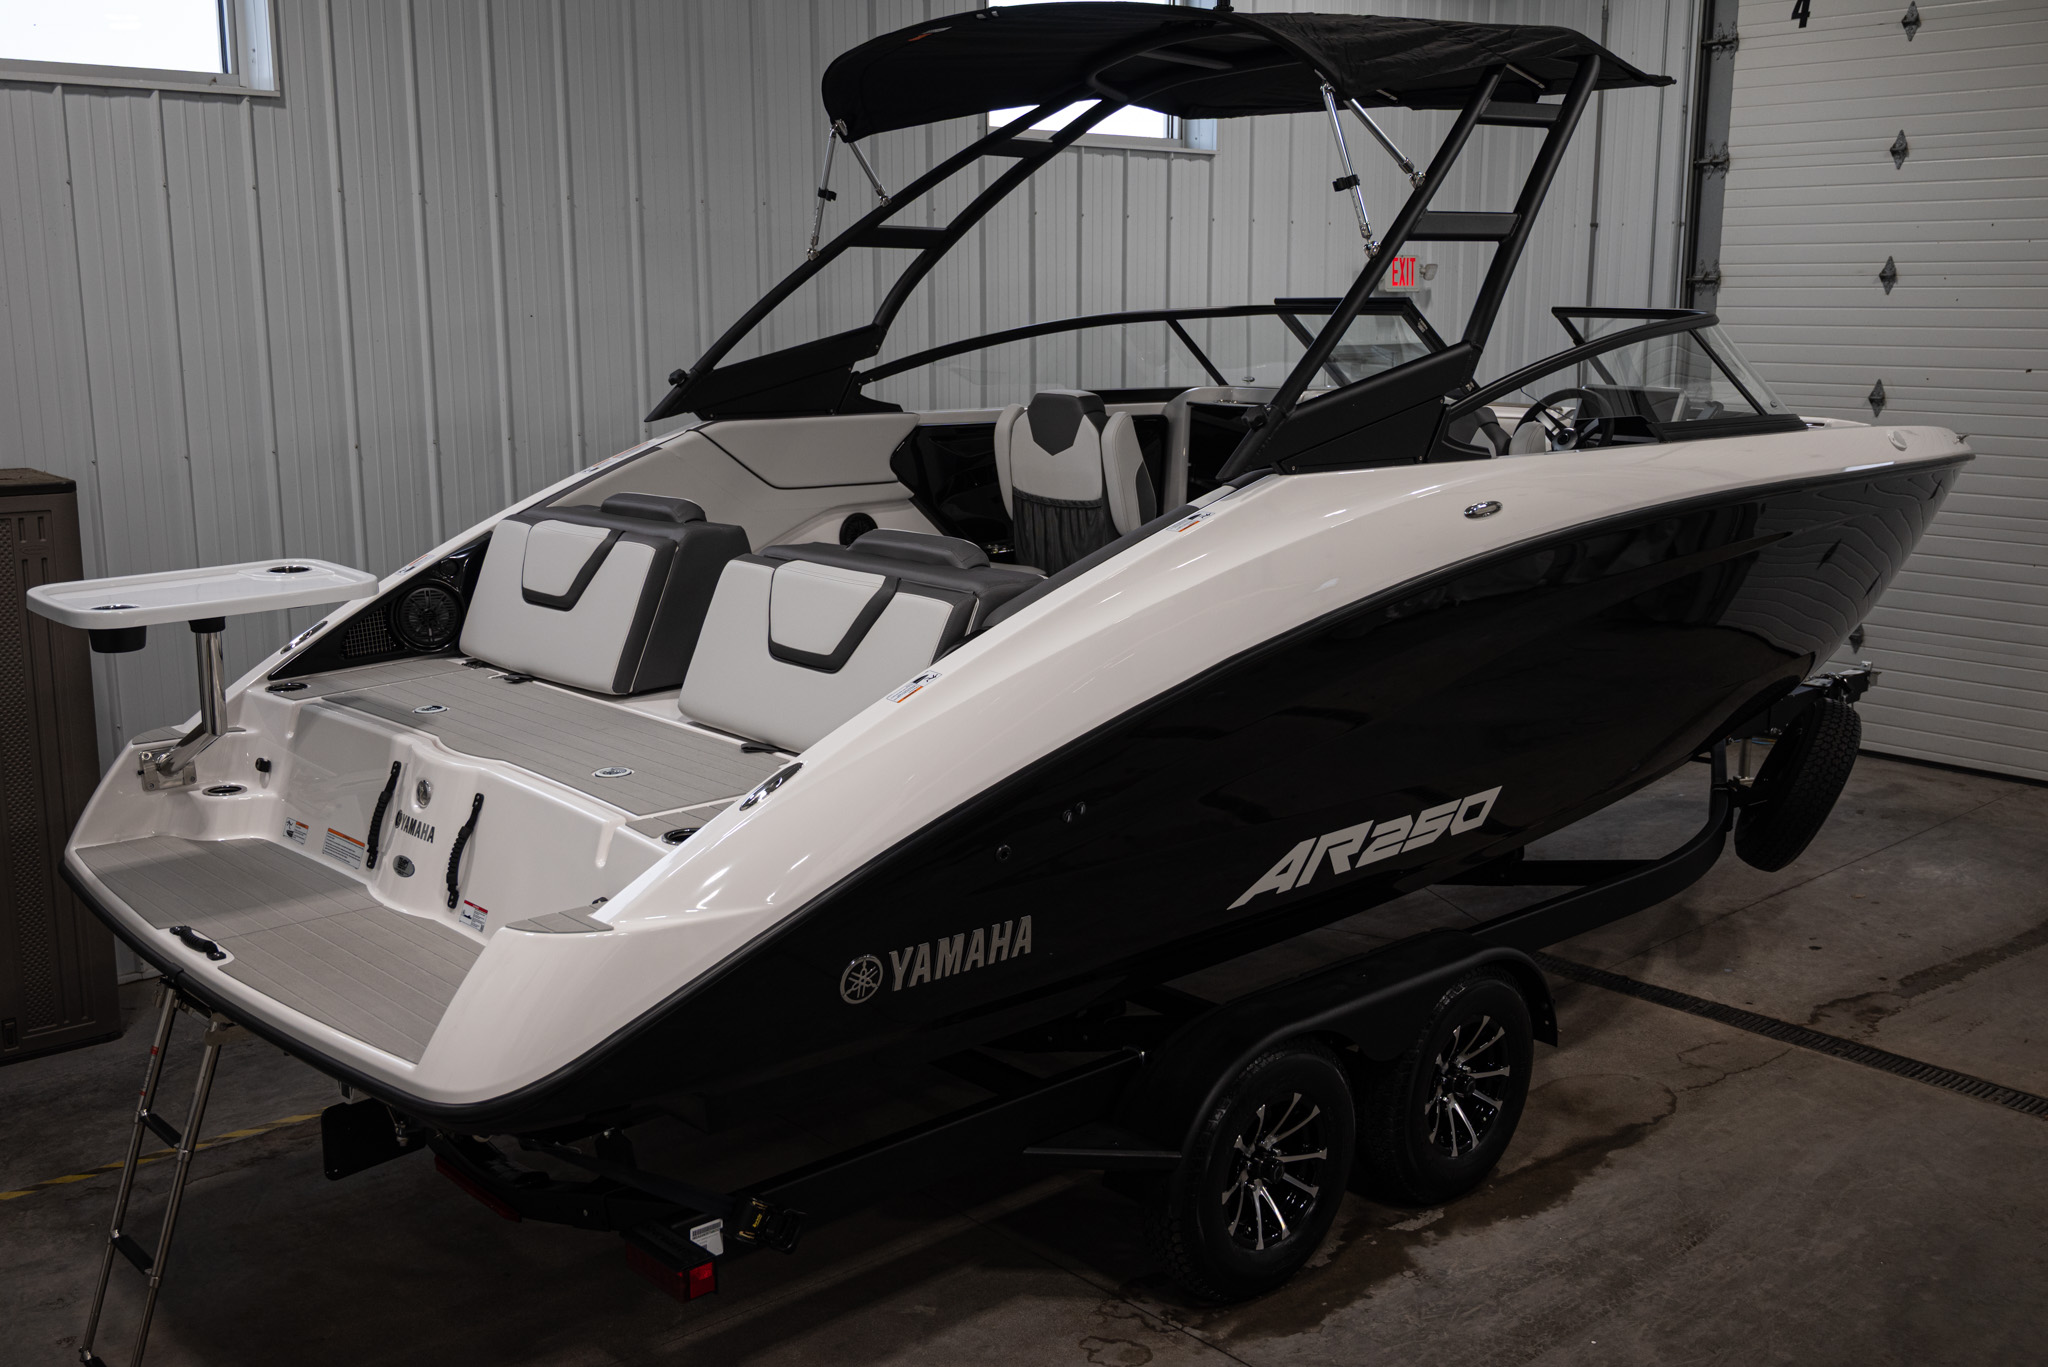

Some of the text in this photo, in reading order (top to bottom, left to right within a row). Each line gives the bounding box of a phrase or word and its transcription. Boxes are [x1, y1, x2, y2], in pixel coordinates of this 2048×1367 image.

[1791, 0, 1811, 29] 4
[1392, 257, 1416, 287] EXIT
[400, 813, 436, 844] YAMAHA
[1226, 785, 1503, 911] AR250
[888, 914, 1032, 992] YAMAHA
